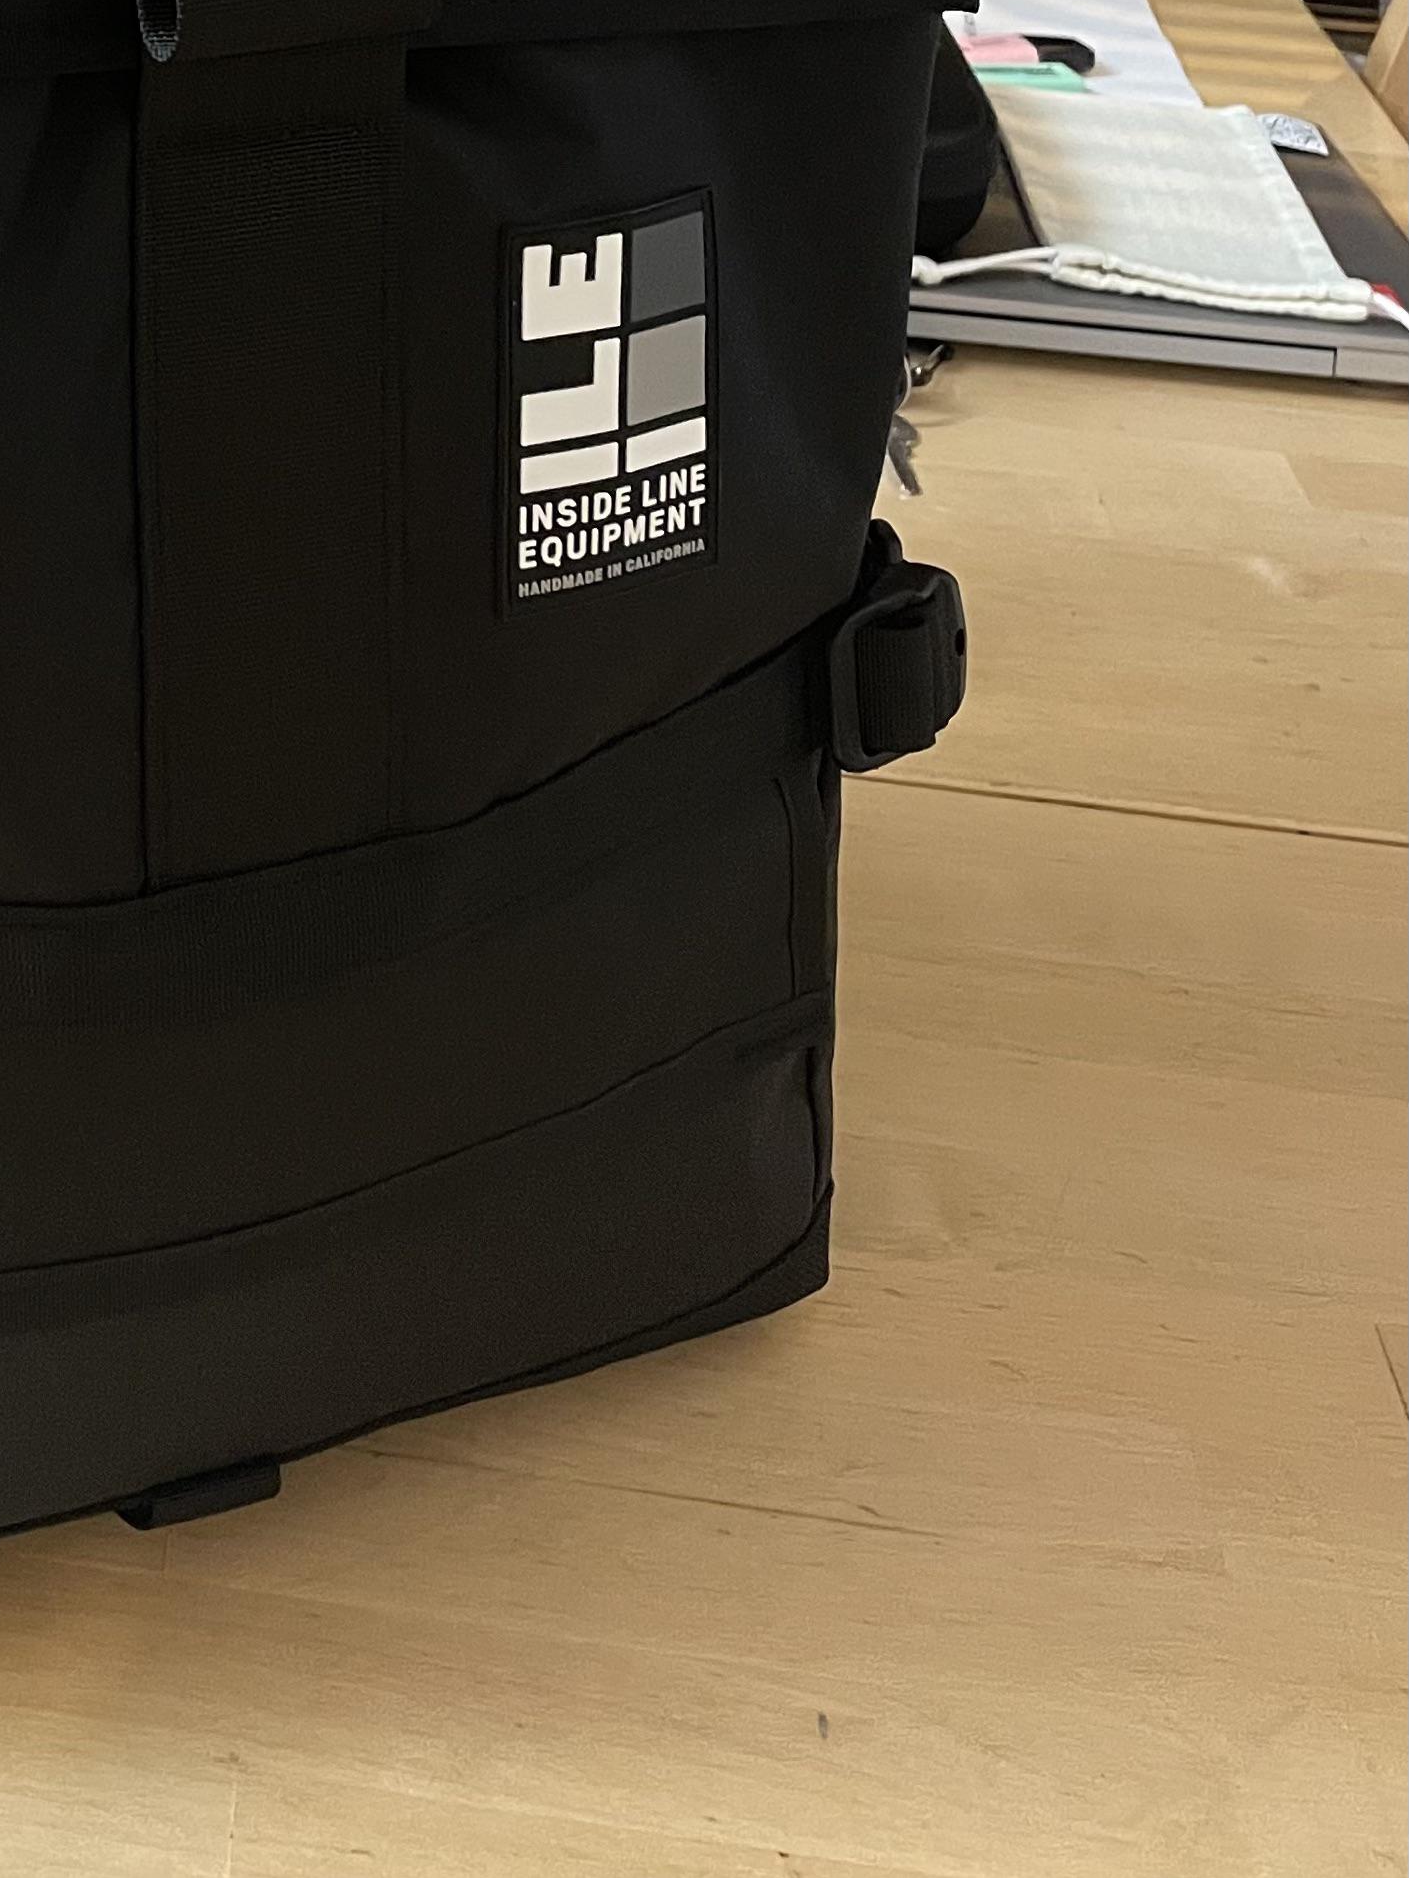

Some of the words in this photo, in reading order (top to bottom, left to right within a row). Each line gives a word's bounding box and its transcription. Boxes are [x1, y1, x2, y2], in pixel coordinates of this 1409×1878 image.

[518, 497, 706, 570] EQUIPMENT
[519, 485, 632, 535] INSIDE
[642, 463, 706, 508] LINE
[518, 567, 604, 598] HANDMADE
[607, 562, 623, 579] IN
[625, 538, 706, 572] CALIFORNIA
